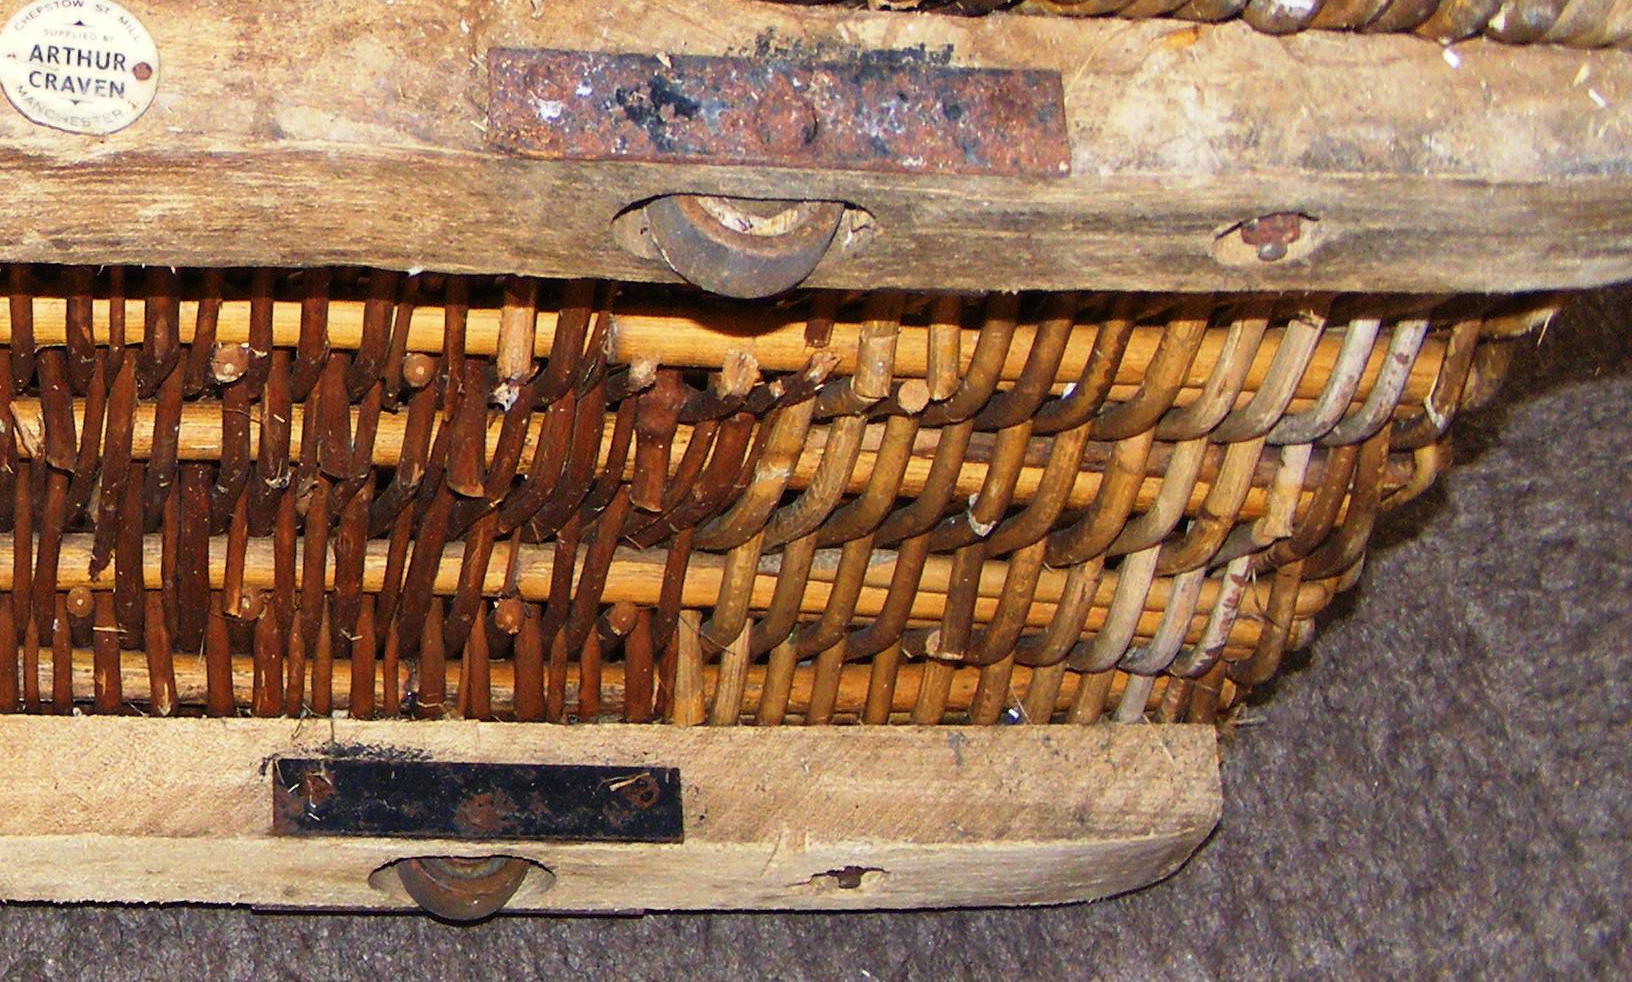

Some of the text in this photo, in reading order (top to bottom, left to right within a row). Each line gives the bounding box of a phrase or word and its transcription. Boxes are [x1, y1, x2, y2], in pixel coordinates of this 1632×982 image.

[117, 15, 141, 42] MILL
[28, 43, 126, 73] ARTHUR
[28, 70, 125, 99] CRAVEN
[16, 85, 122, 128] MANCHESTER
